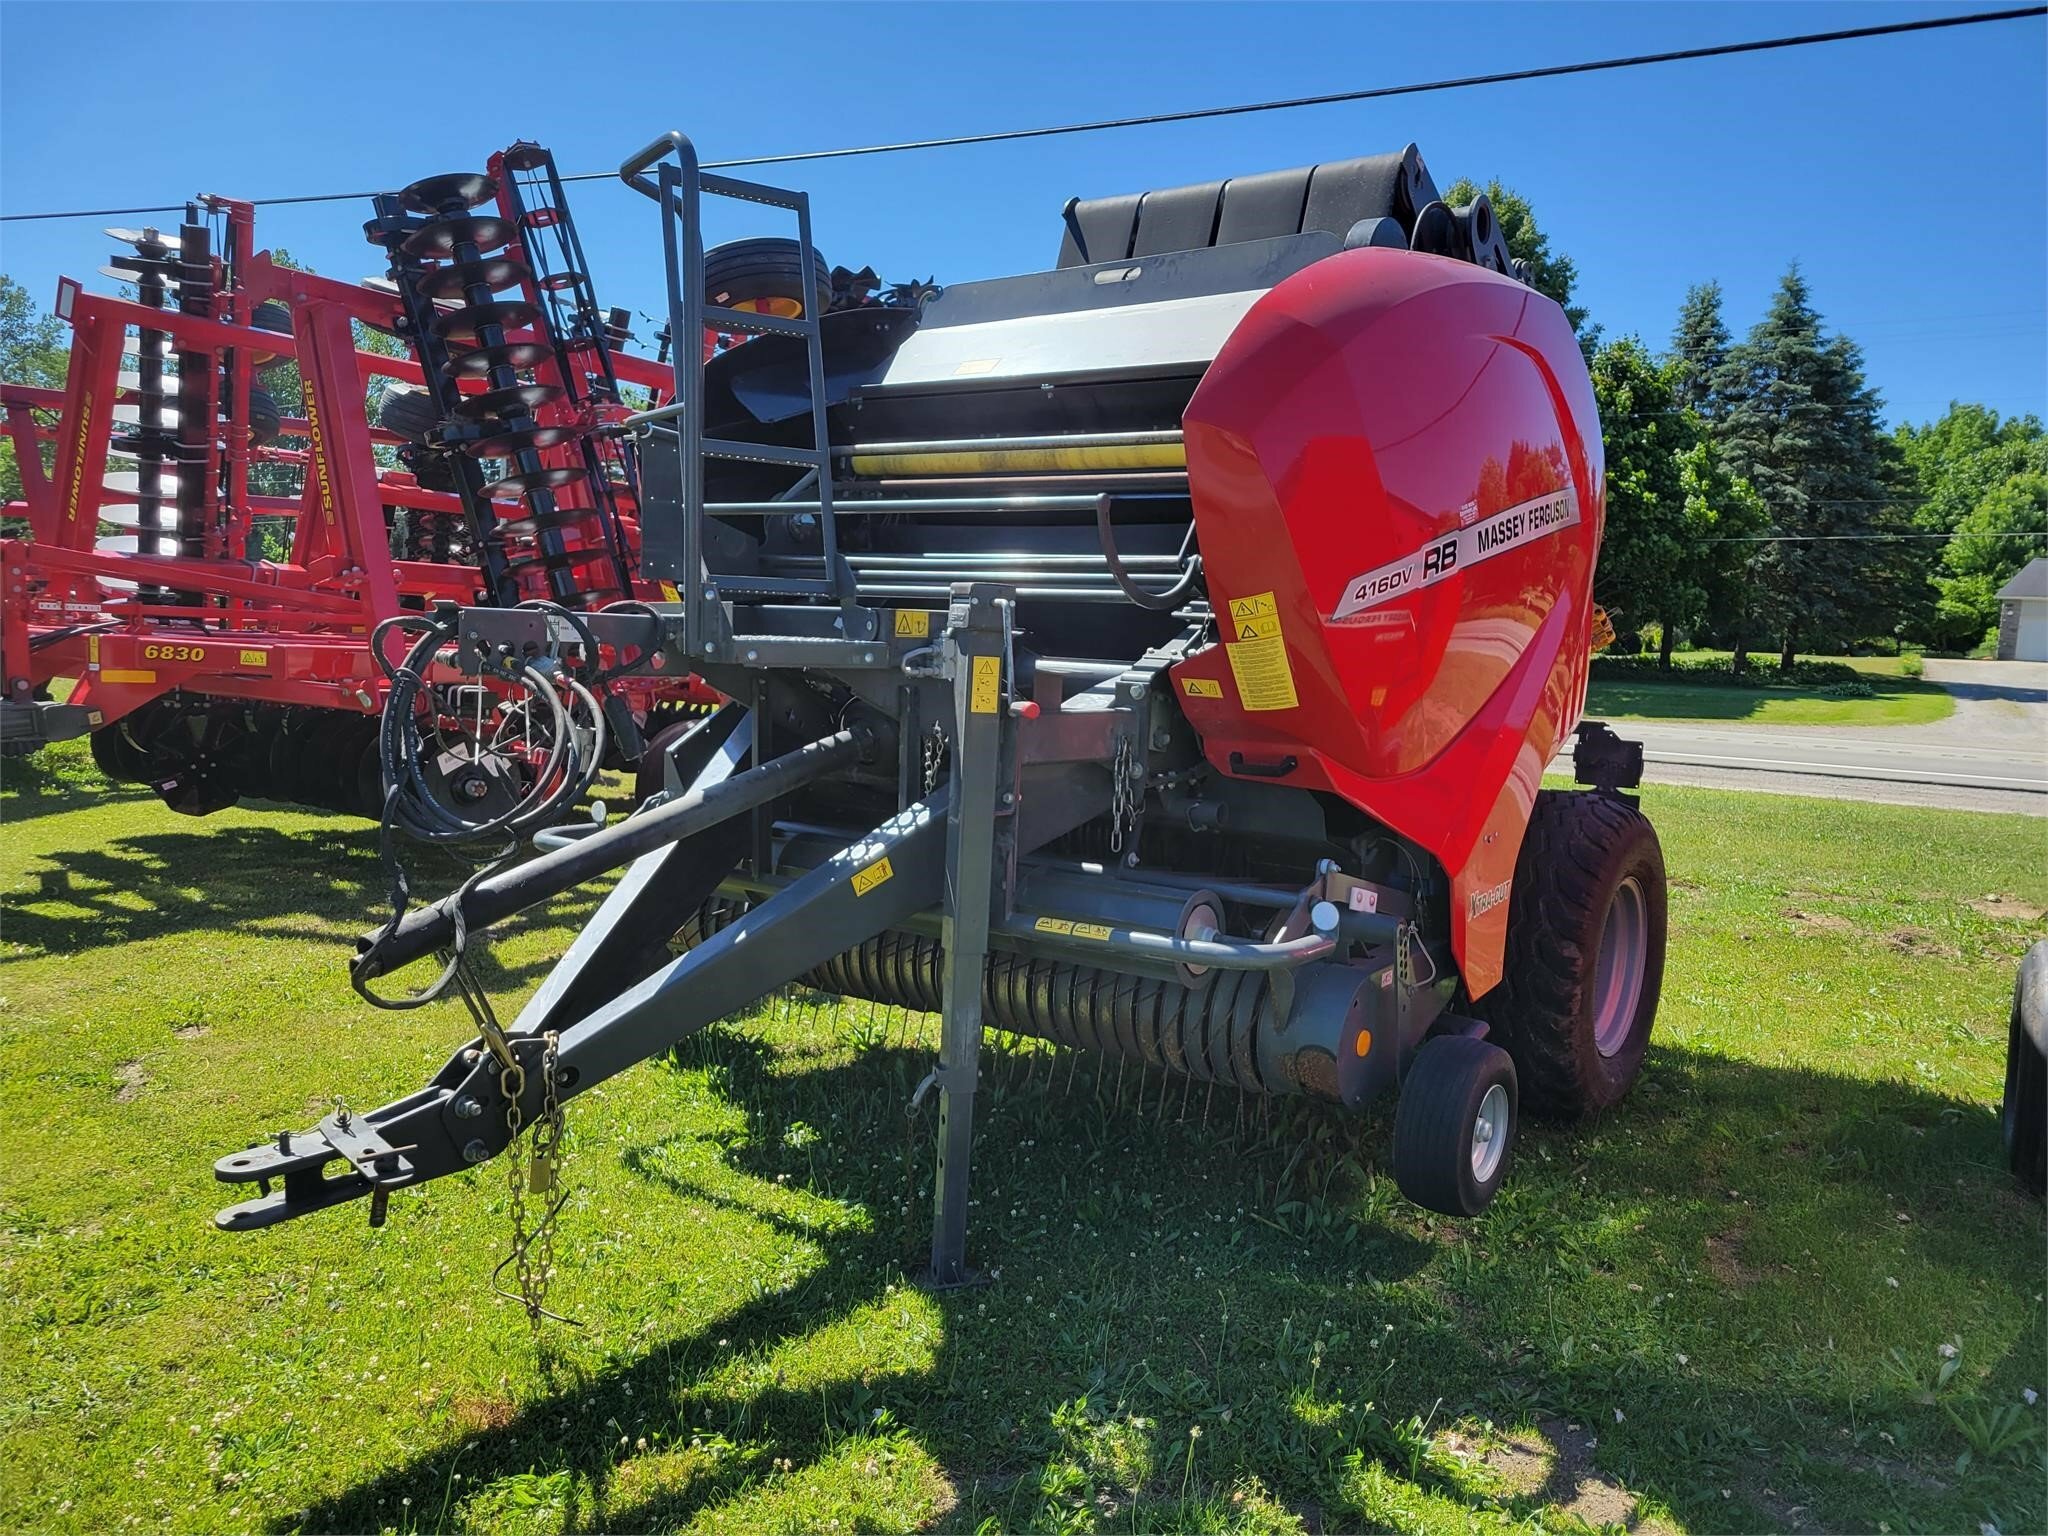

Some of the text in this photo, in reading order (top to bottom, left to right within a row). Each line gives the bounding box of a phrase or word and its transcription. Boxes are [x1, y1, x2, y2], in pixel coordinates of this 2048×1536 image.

[69, 405, 91, 521] SUNFLOWER
[304, 379, 333, 509] SUNFLOWER
[1355, 498, 1570, 601] 4160V RB MASSEY FERGUSON
[144, 645, 205, 662] 6830
